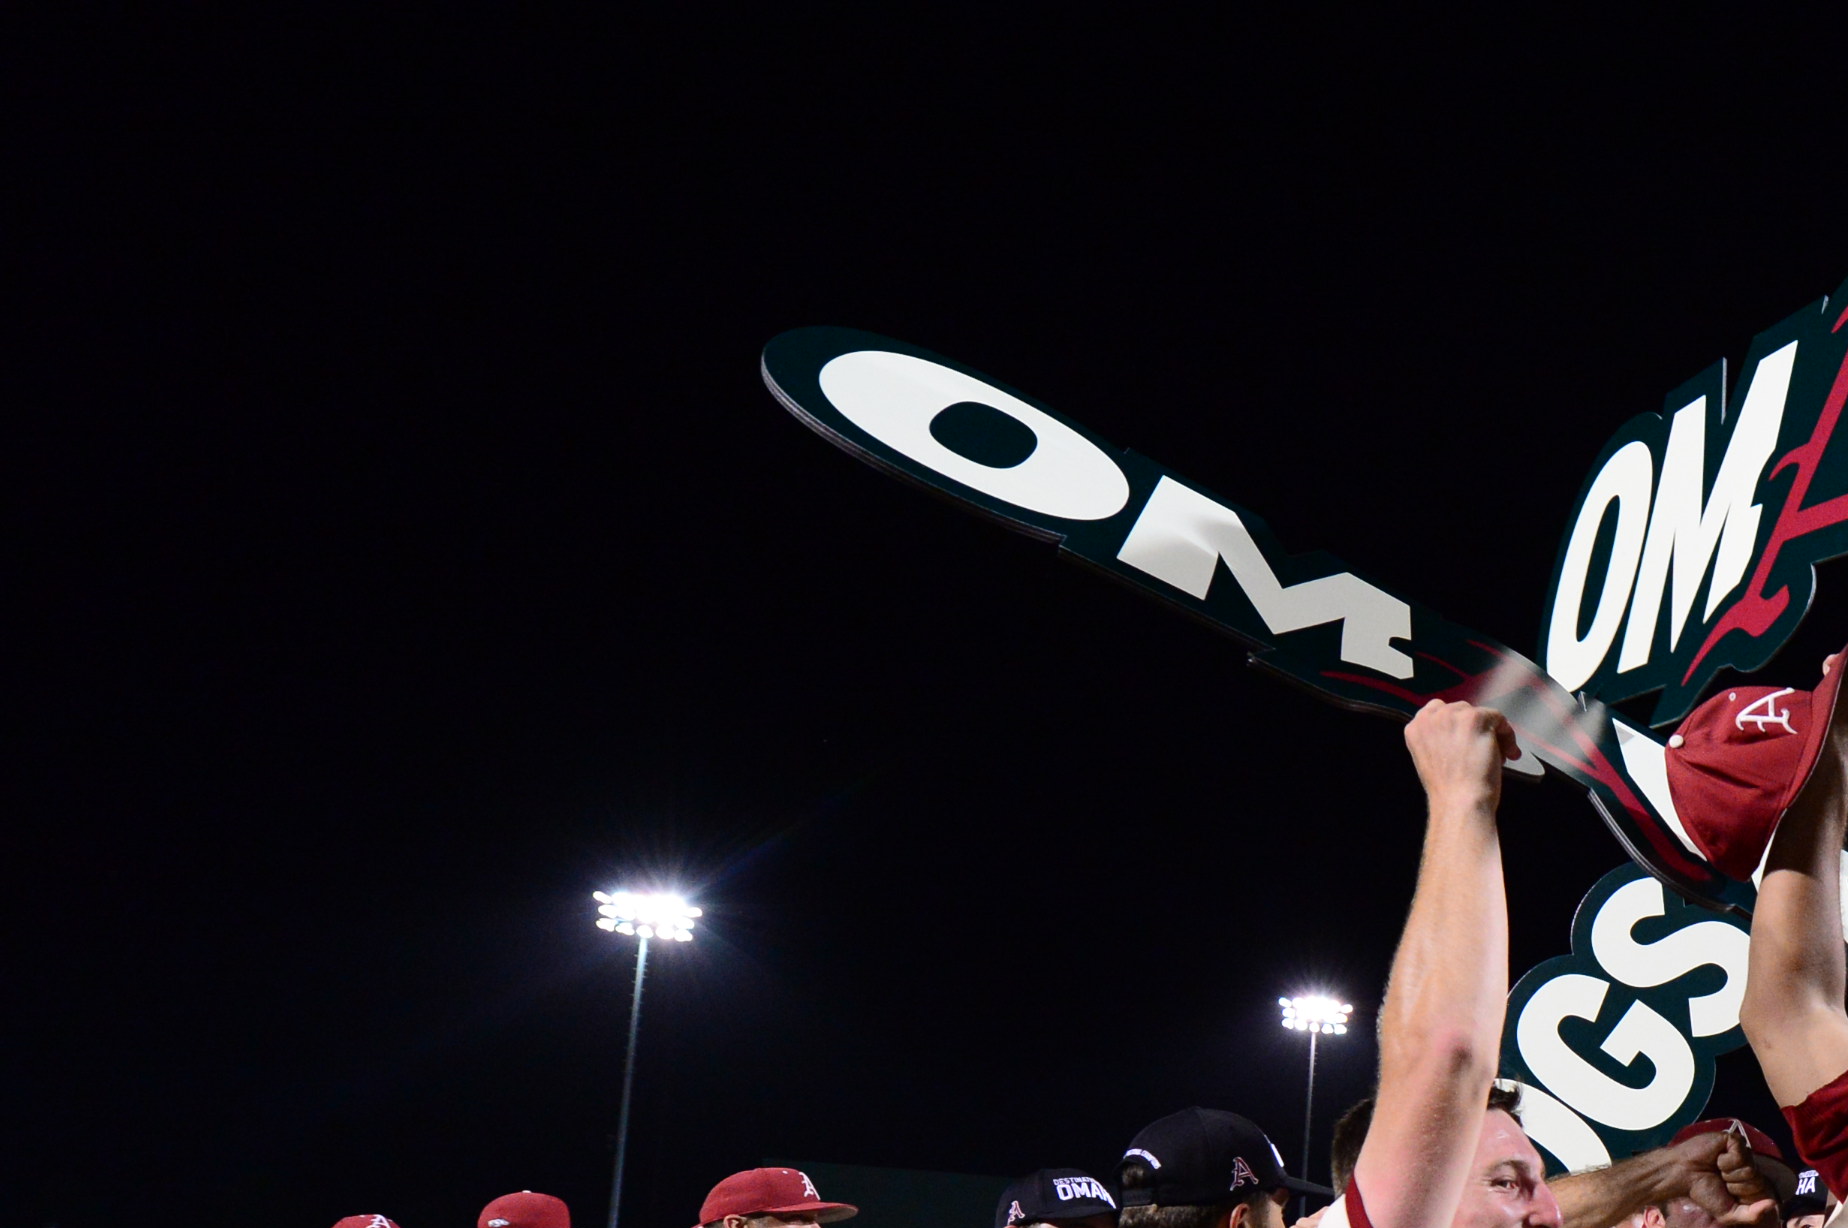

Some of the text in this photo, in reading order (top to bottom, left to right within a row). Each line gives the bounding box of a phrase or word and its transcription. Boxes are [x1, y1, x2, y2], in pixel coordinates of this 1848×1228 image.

[1735, 687, 1799, 735] A
[798, 1171, 821, 1201] A
[1229, 1156, 1259, 1191] A
[1007, 1200, 1026, 1225] A
